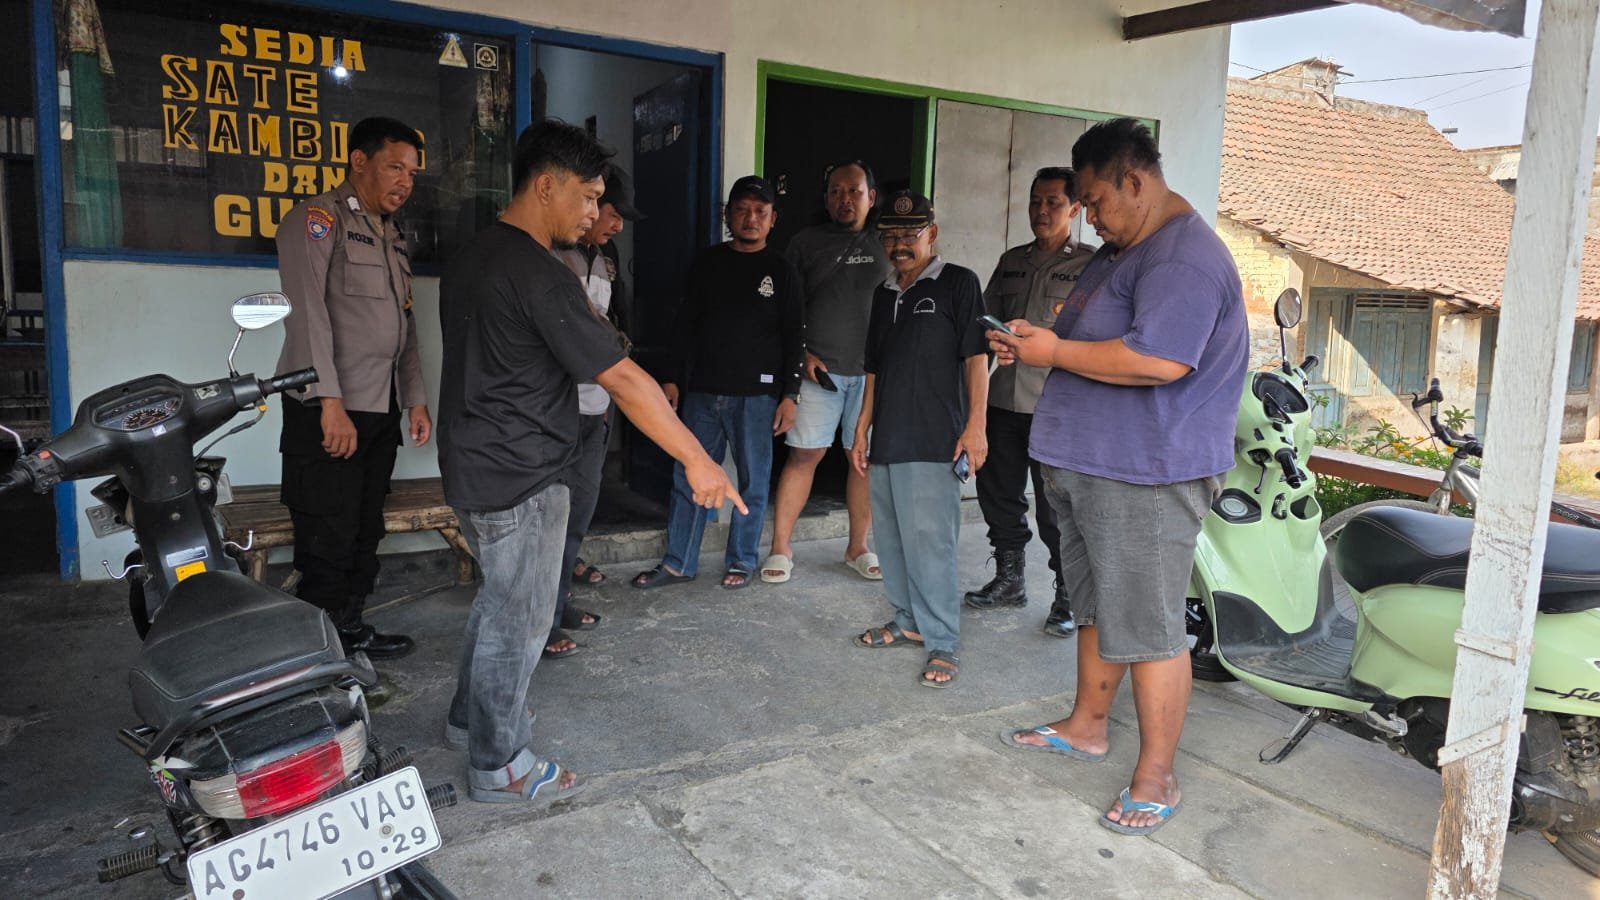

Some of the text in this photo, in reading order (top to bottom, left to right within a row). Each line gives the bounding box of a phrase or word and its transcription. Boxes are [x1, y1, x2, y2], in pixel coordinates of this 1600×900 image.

[219, 23, 366, 72] SEDIA
[160, 53, 318, 114] SATE
[162, 103, 426, 170] KAMBI
[263, 161, 346, 195] DAN
[213, 193, 302, 239] GU
[350, 780, 416, 830] VAG
